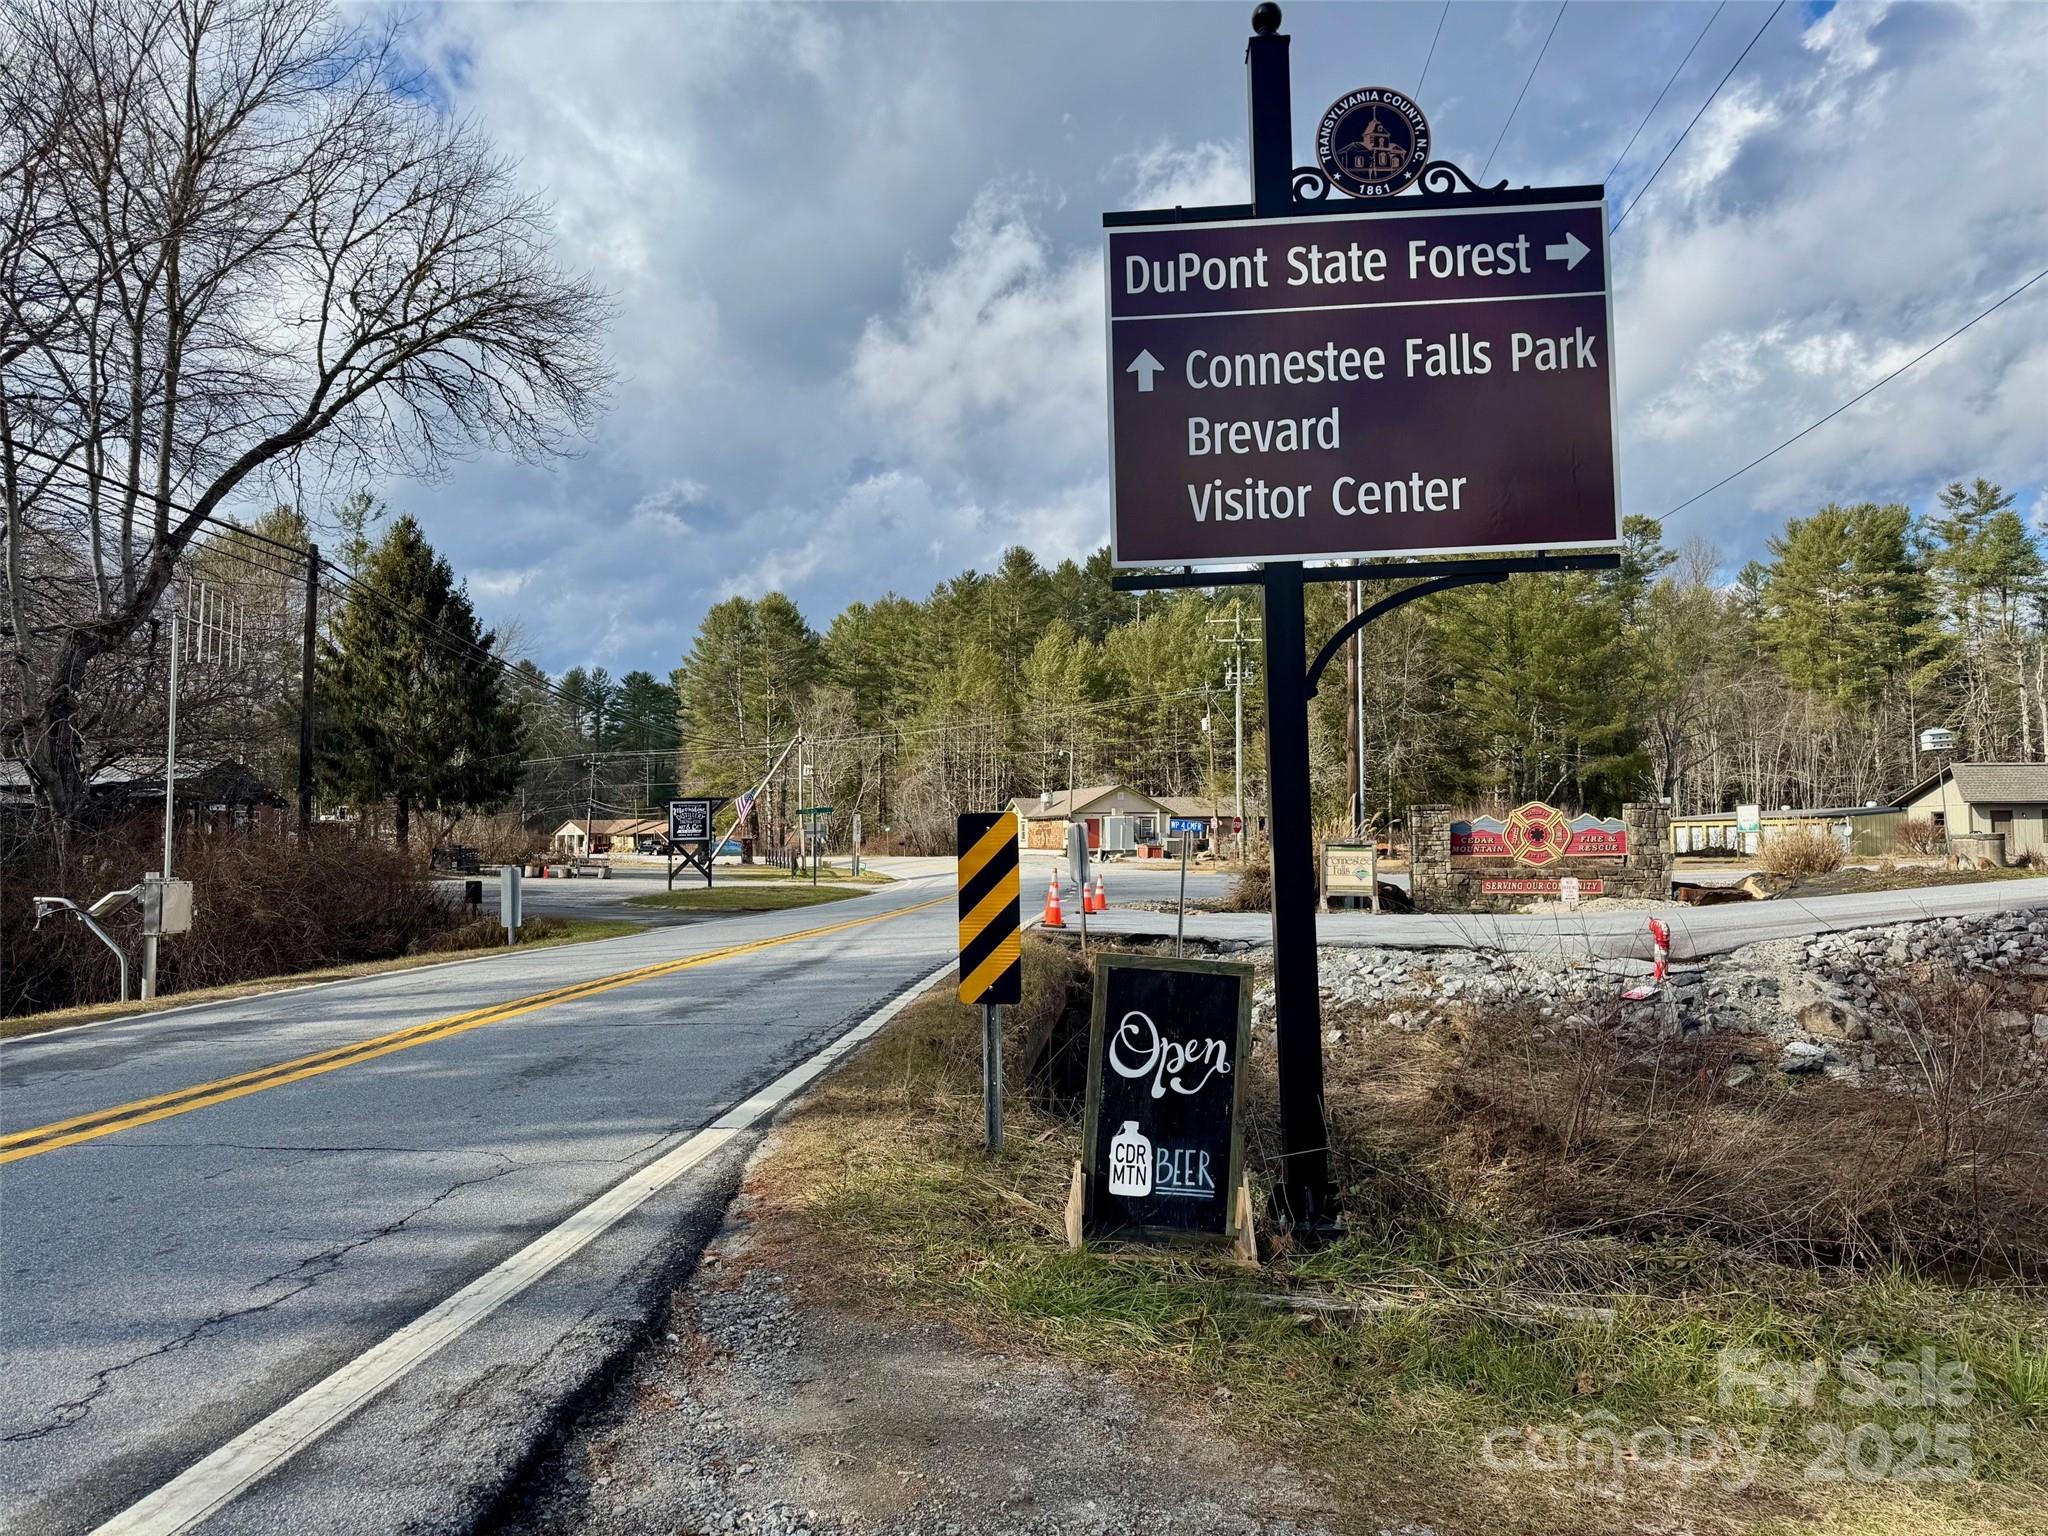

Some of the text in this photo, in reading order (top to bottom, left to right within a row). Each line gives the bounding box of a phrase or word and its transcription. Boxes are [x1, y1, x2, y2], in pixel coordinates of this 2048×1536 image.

[1319, 91, 1379, 163] TRANSYLVANIA
[1383, 92, 1426, 135] COUNTY,
[1359, 183, 1391, 195] 1861
[1126, 234, 1531, 294] DuPont State Forest
[1186, 326, 1598, 389] Connestee Falls Park
[1188, 406, 1340, 456] Brevard
[1187, 471, 1467, 522] Visitor Center
[1578, 844, 1618, 852] RESCUE
[1580, 835, 1604, 843] FIRE
[1486, 881, 1523, 890] SERVING
[1526, 882, 1544, 890] OUR
[1546, 881, 1598, 890] CONITY
[1109, 1011, 1231, 1098] Open
[1115, 1143, 1146, 1165] CDR
[1156, 1147, 1215, 1188] BEER
[1112, 1164, 1147, 1186] MTN
